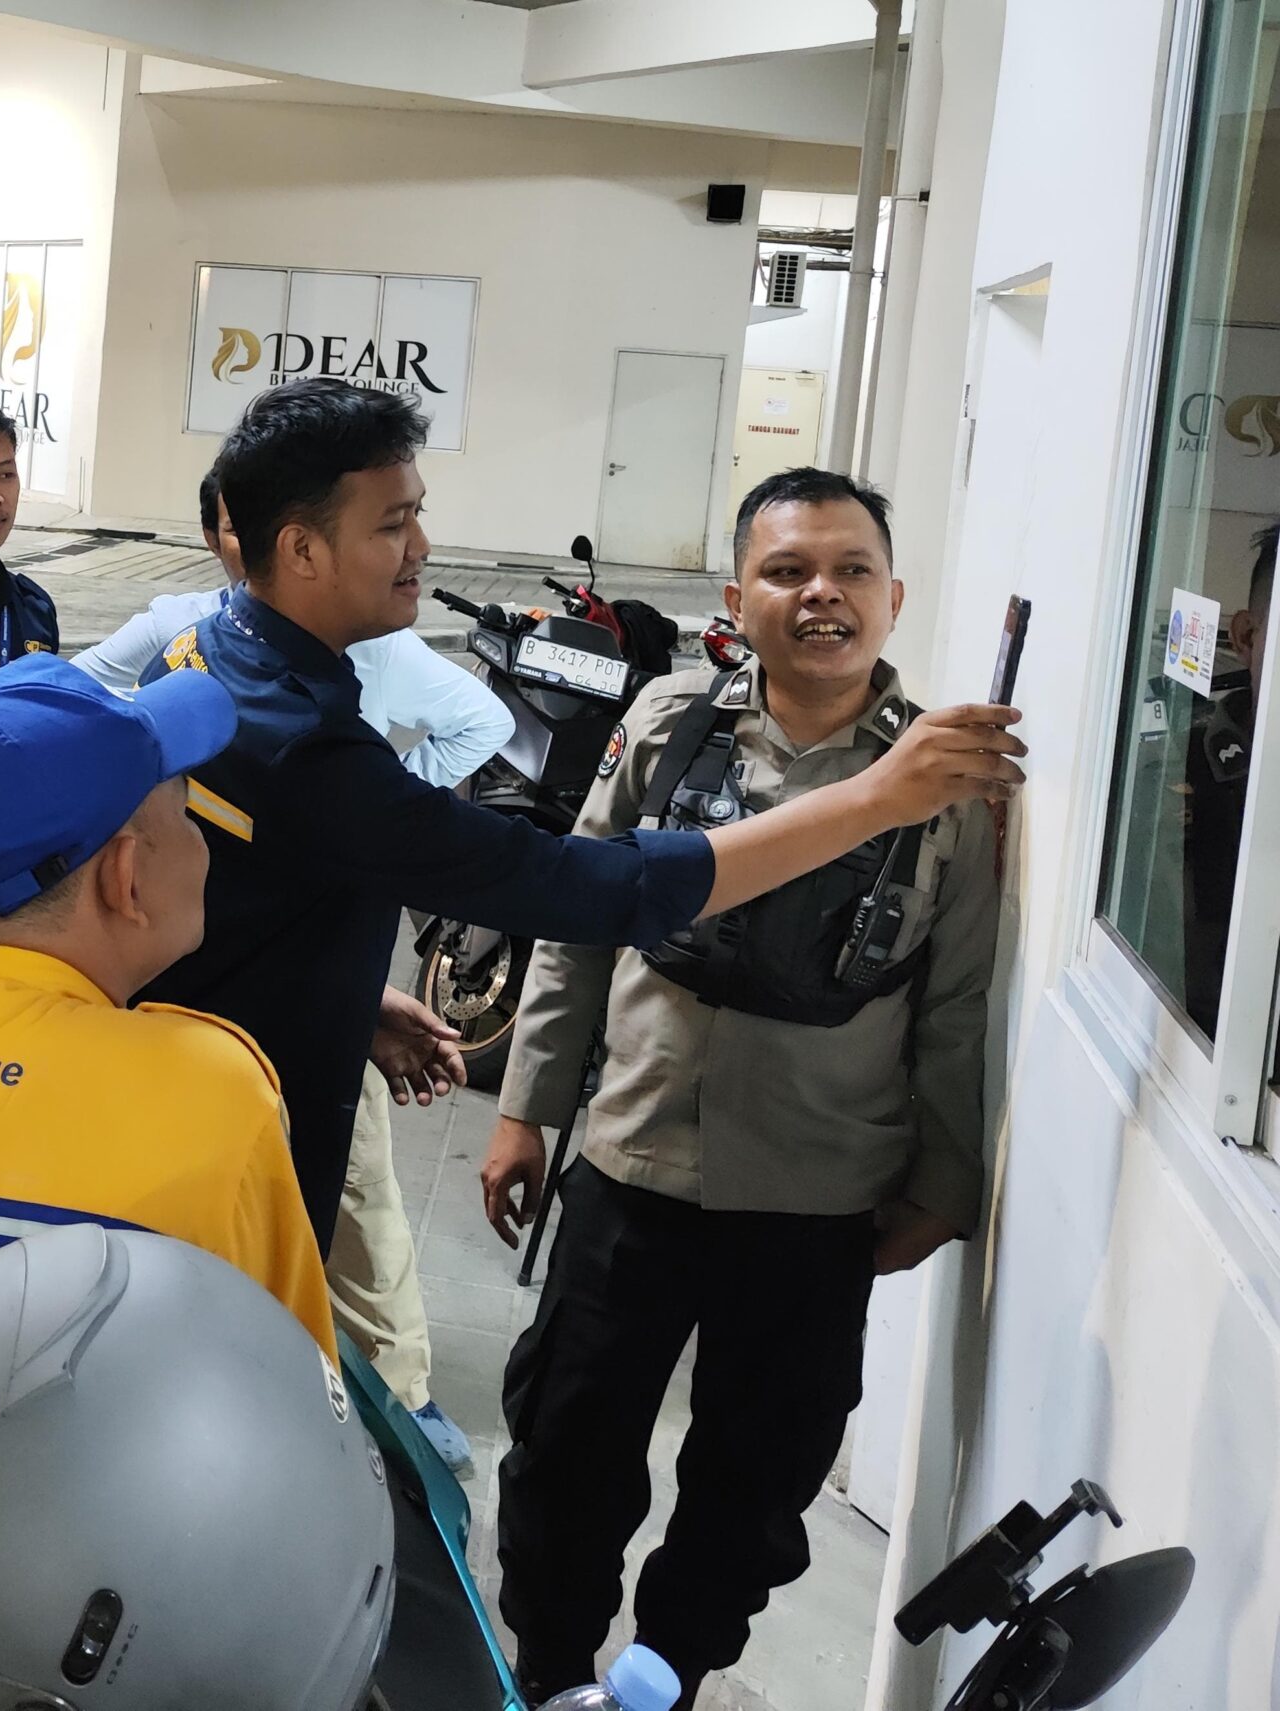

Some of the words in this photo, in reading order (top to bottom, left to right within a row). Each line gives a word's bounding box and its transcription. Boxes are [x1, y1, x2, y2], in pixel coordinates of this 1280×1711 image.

[263, 332, 448, 394] DEAR
[344, 378, 420, 394] OUNGE
[748, 424, 771, 433] TANGGA
[525, 640, 536, 655] B
[548, 645, 588, 668] 3417
[594, 658, 625, 679] POT
